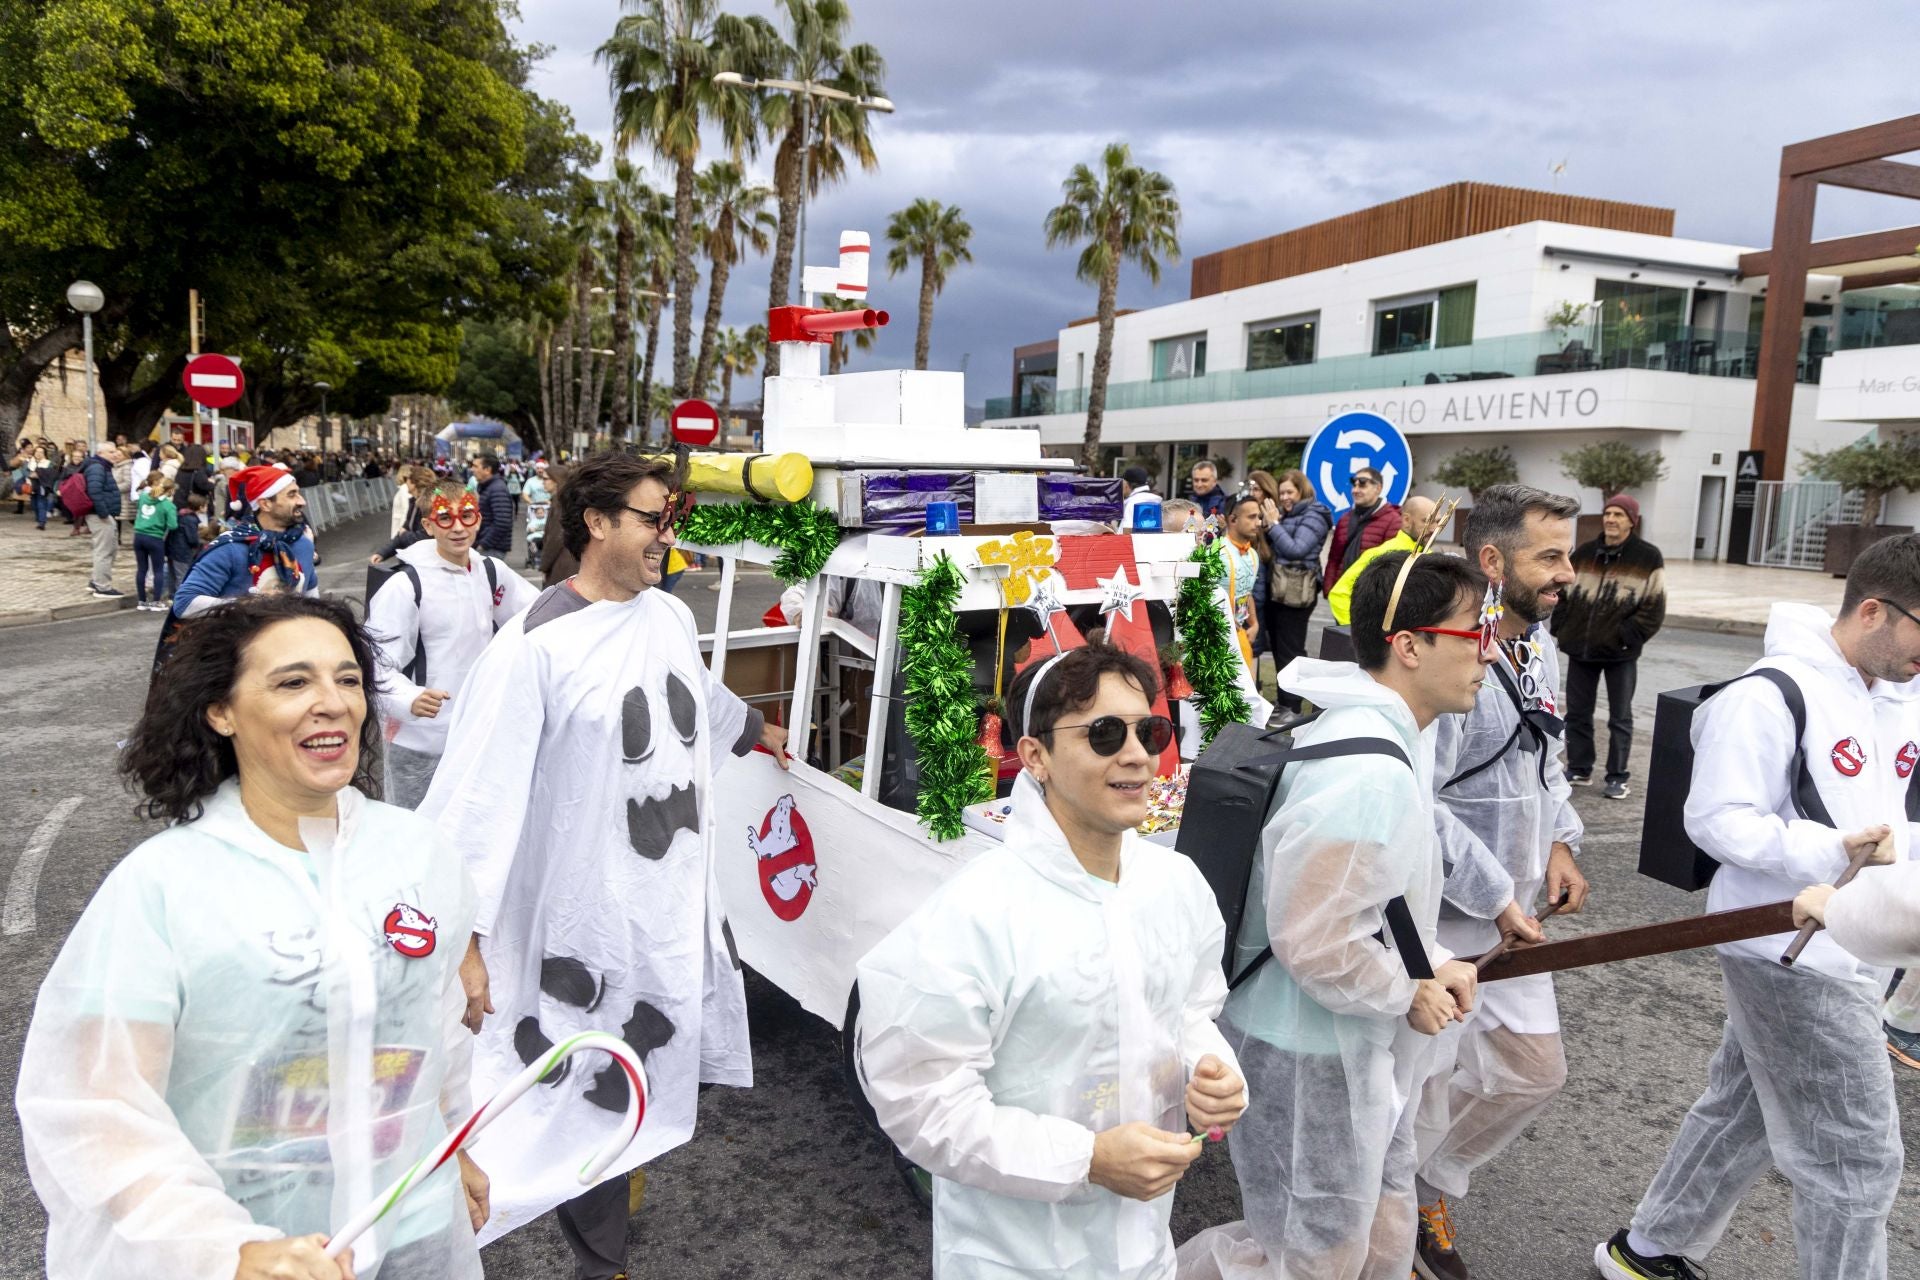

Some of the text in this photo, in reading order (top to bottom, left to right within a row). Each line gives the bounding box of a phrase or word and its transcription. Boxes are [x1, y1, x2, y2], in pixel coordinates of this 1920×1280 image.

[1858, 378, 1896, 394] Mar.
[1441, 387, 1599, 422] ALVIENTO
[1738, 455, 1759, 476] A
[1113, 591, 1128, 599] NEW
